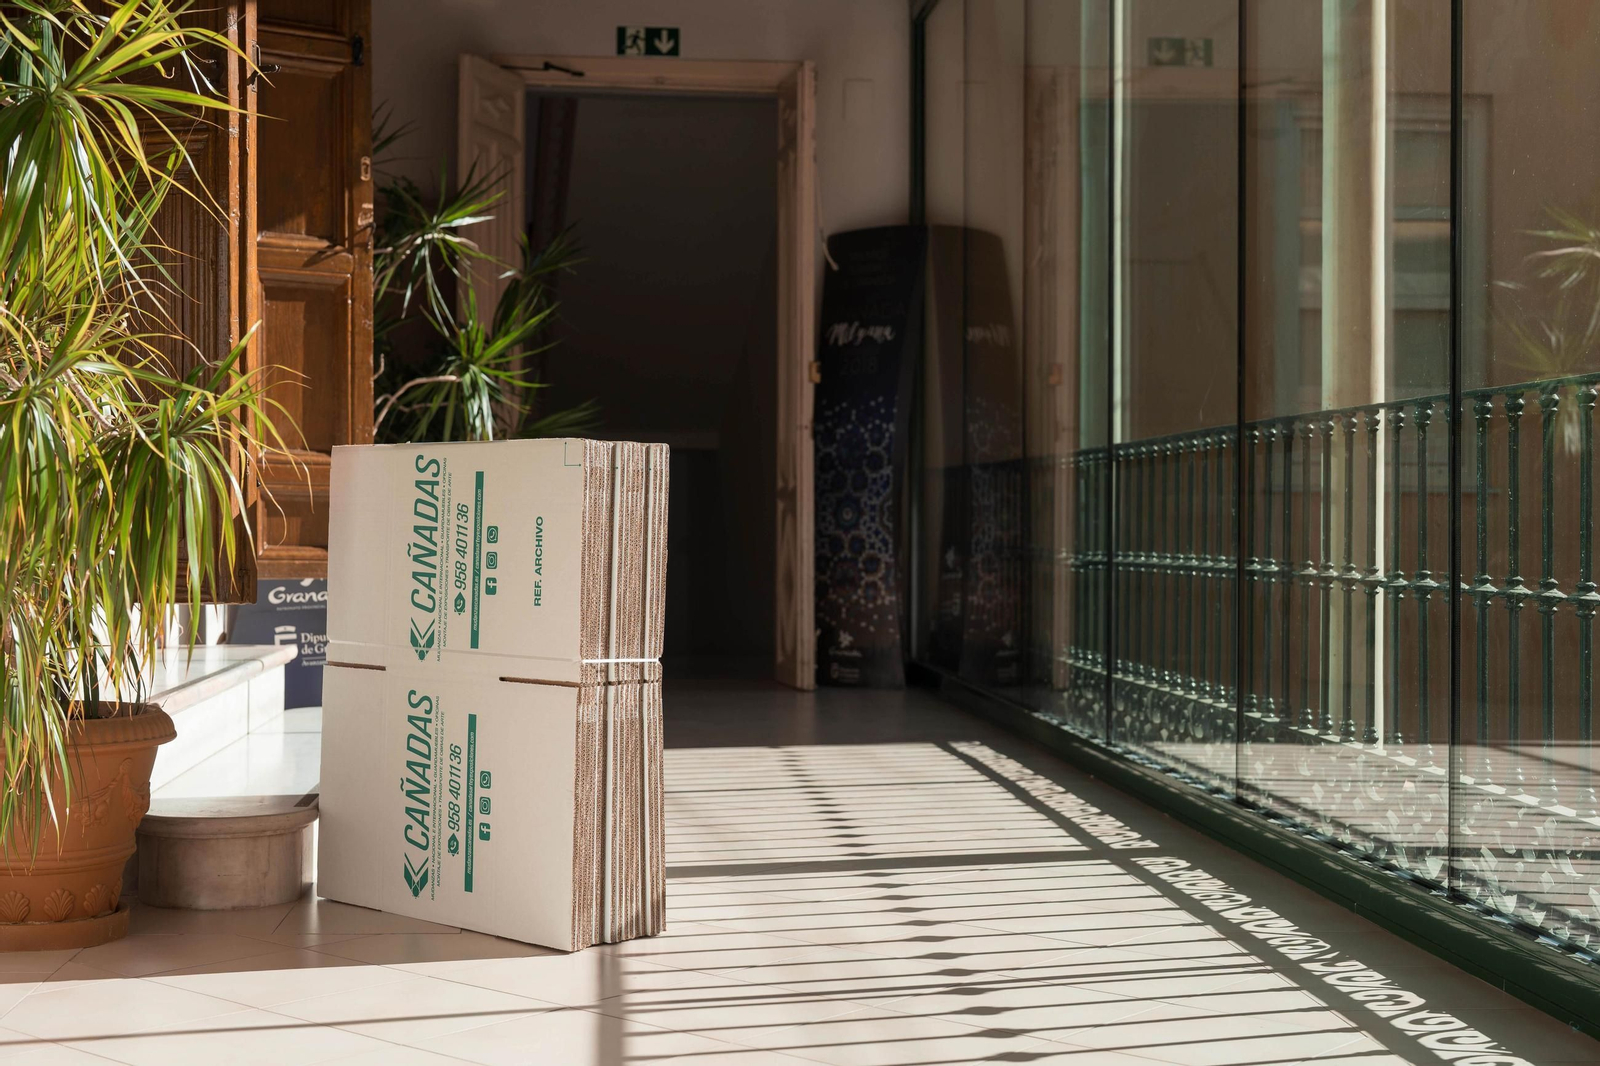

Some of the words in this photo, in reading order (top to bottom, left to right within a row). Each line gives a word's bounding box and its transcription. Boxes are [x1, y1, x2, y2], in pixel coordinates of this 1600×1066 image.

[407, 455, 440, 613] CAÑADAS
[535, 516, 543, 576] ARCHIVO
[454, 561, 467, 590] 958
[302, 644, 313, 655] de
[400, 690, 433, 851] CAÑADAS
[448, 801, 460, 832] 958
